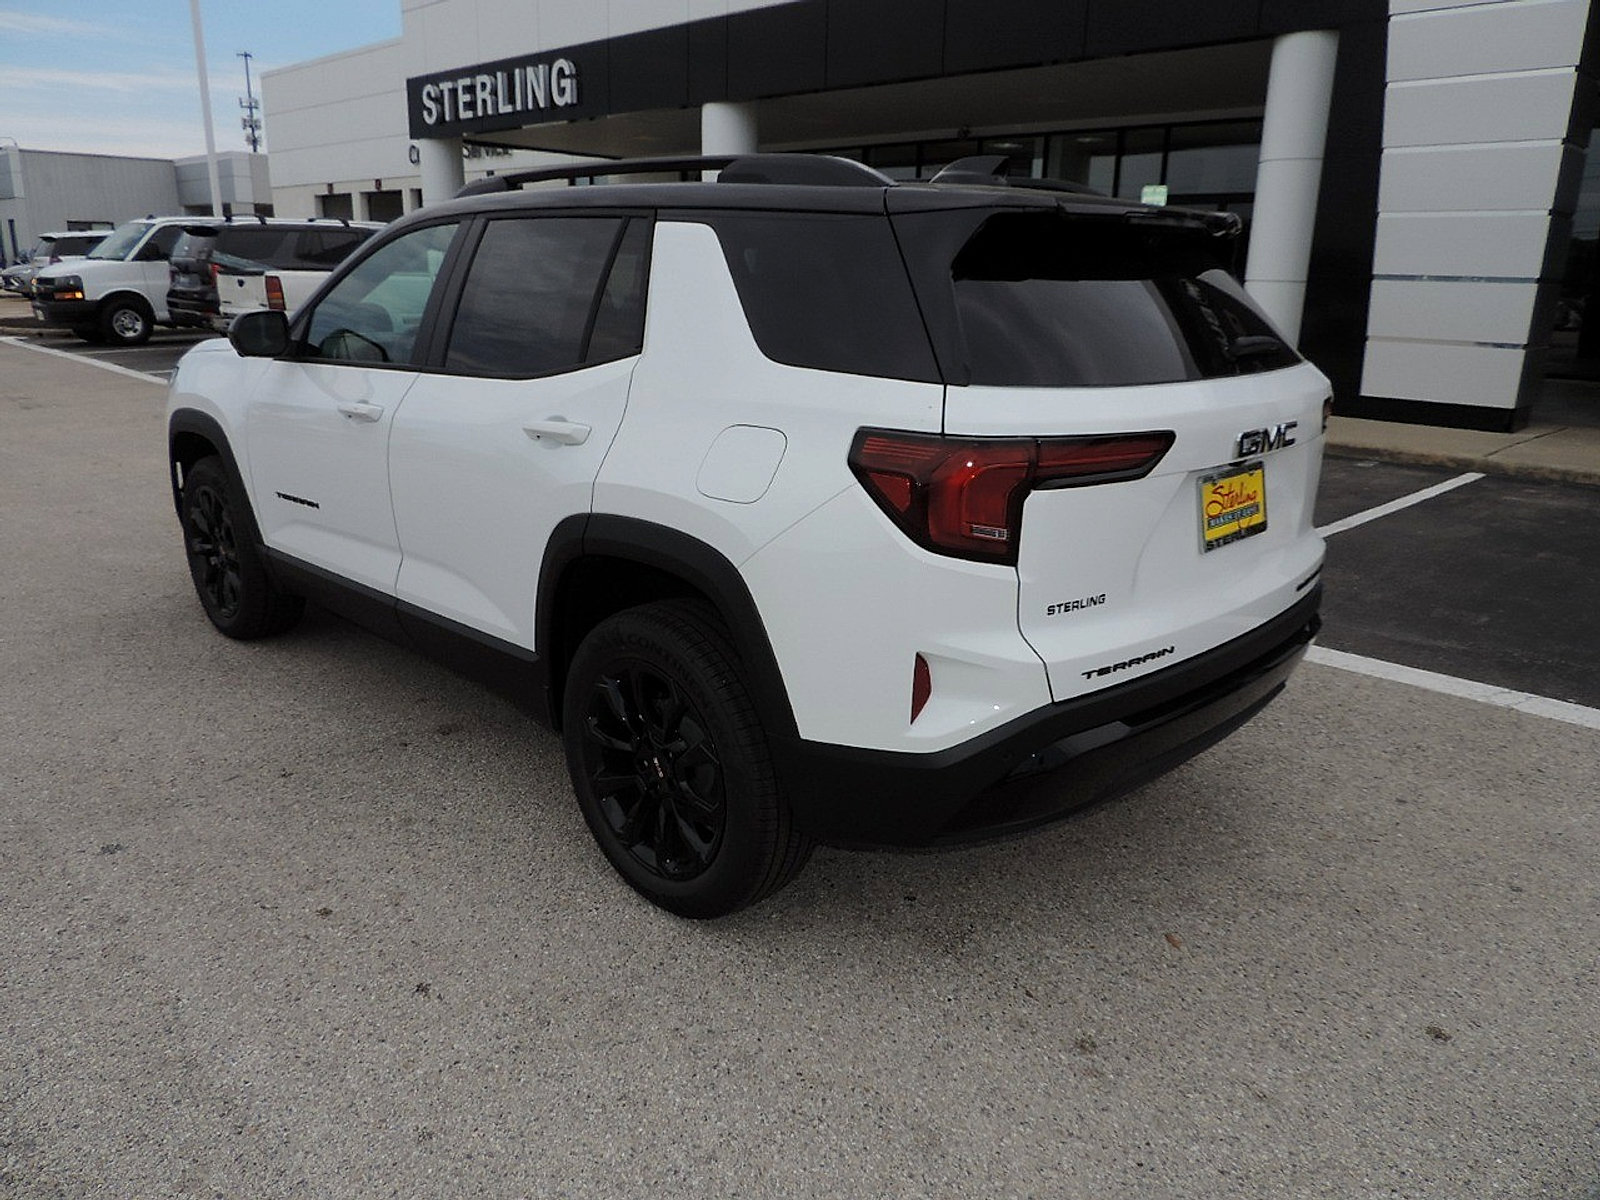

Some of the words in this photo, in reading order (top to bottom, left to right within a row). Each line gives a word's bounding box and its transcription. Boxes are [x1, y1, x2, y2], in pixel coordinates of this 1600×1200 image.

[422, 57, 577, 126] STERLING
[1236, 420, 1297, 458] GMC
[1046, 593, 1107, 616] STERLING
[1081, 645, 1175, 680] TERRAIN
